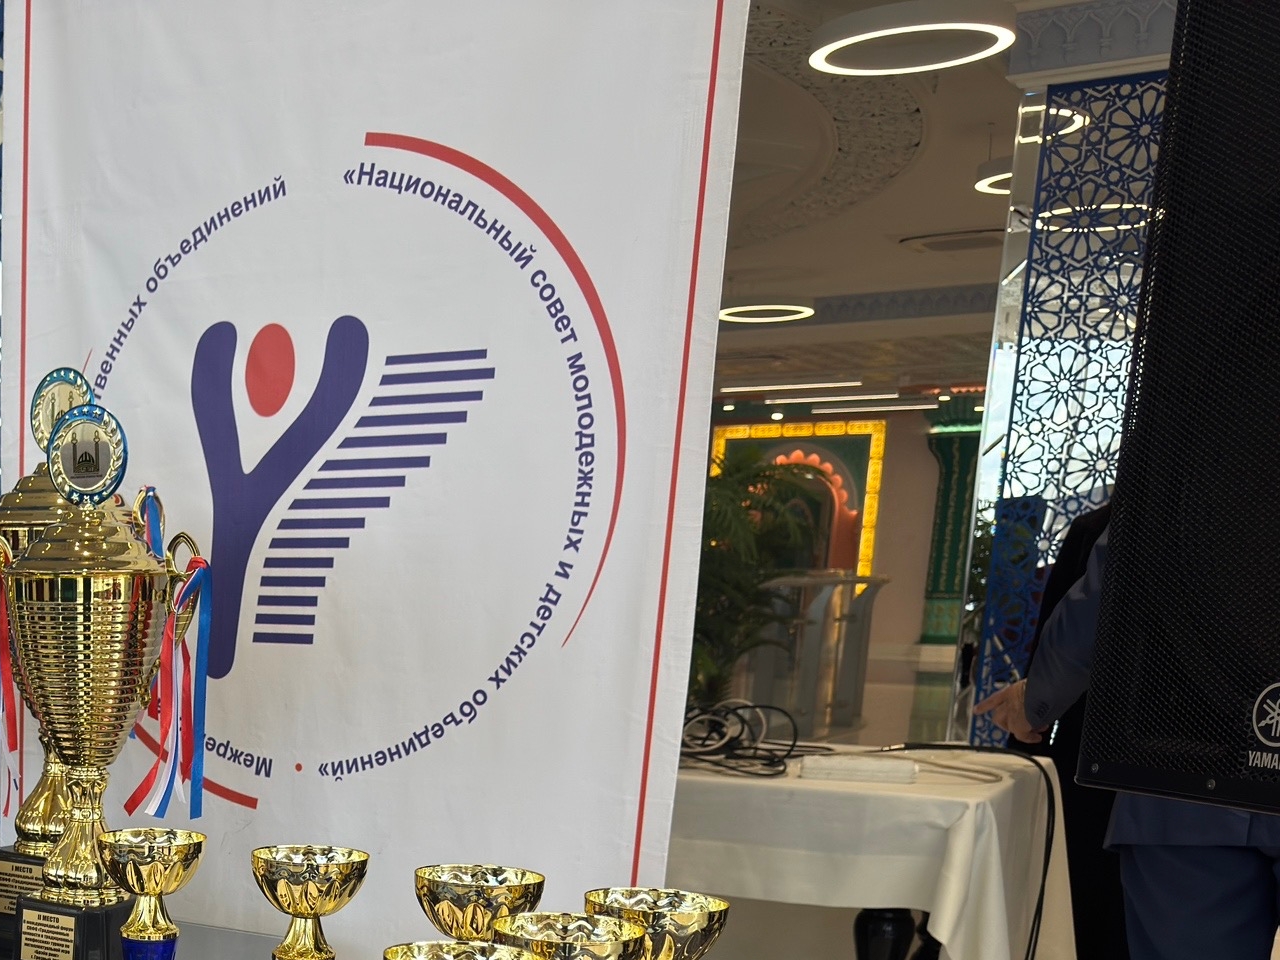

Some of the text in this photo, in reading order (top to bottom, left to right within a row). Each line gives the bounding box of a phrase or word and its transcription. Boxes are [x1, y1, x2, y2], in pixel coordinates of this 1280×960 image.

[93, 175, 288, 778] Межре твенных объединений
[317, 161, 597, 783] «Национальный совет молодежных и детских объединений»
[15, 866, 32, 874] МЕСТО
[42, 914, 60, 924] МЕСТО
